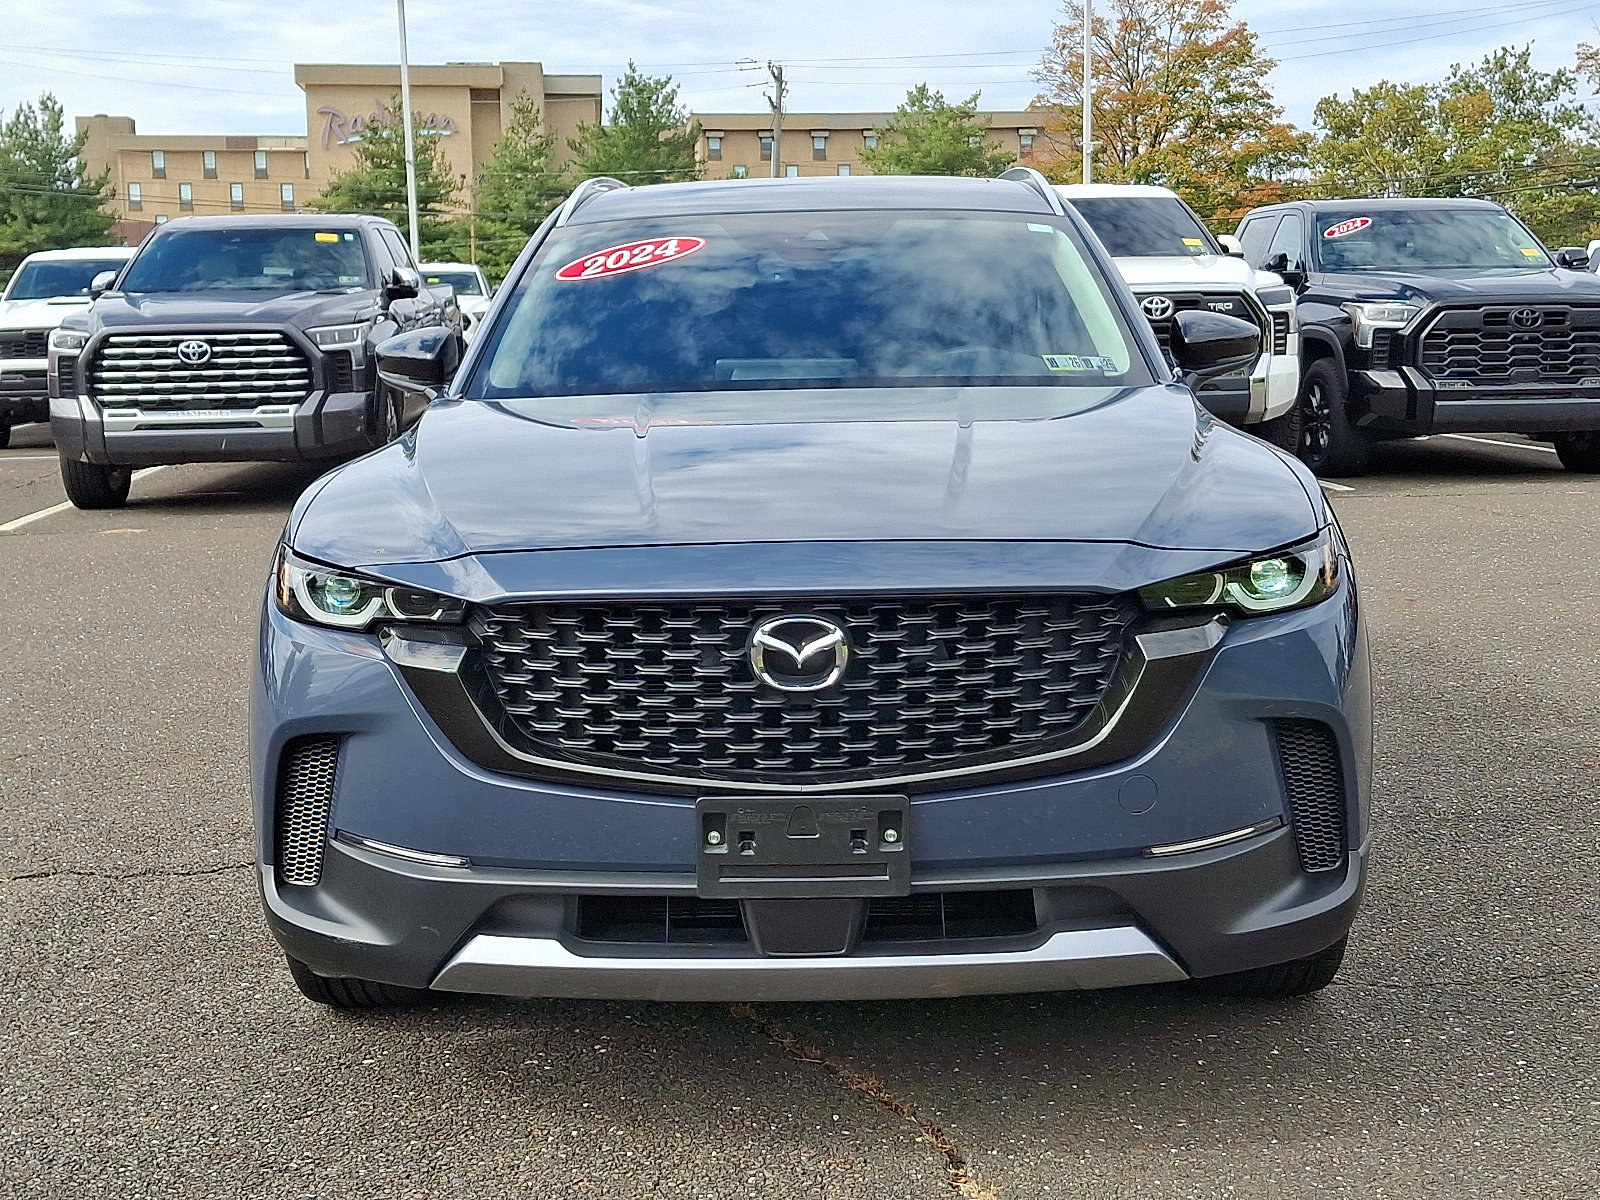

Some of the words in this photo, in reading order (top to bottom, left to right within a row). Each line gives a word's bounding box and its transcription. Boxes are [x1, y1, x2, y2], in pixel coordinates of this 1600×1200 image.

[1333, 219, 1362, 236] 2024
[581, 239, 681, 277] 2024
[1207, 302, 1233, 312] TRD
